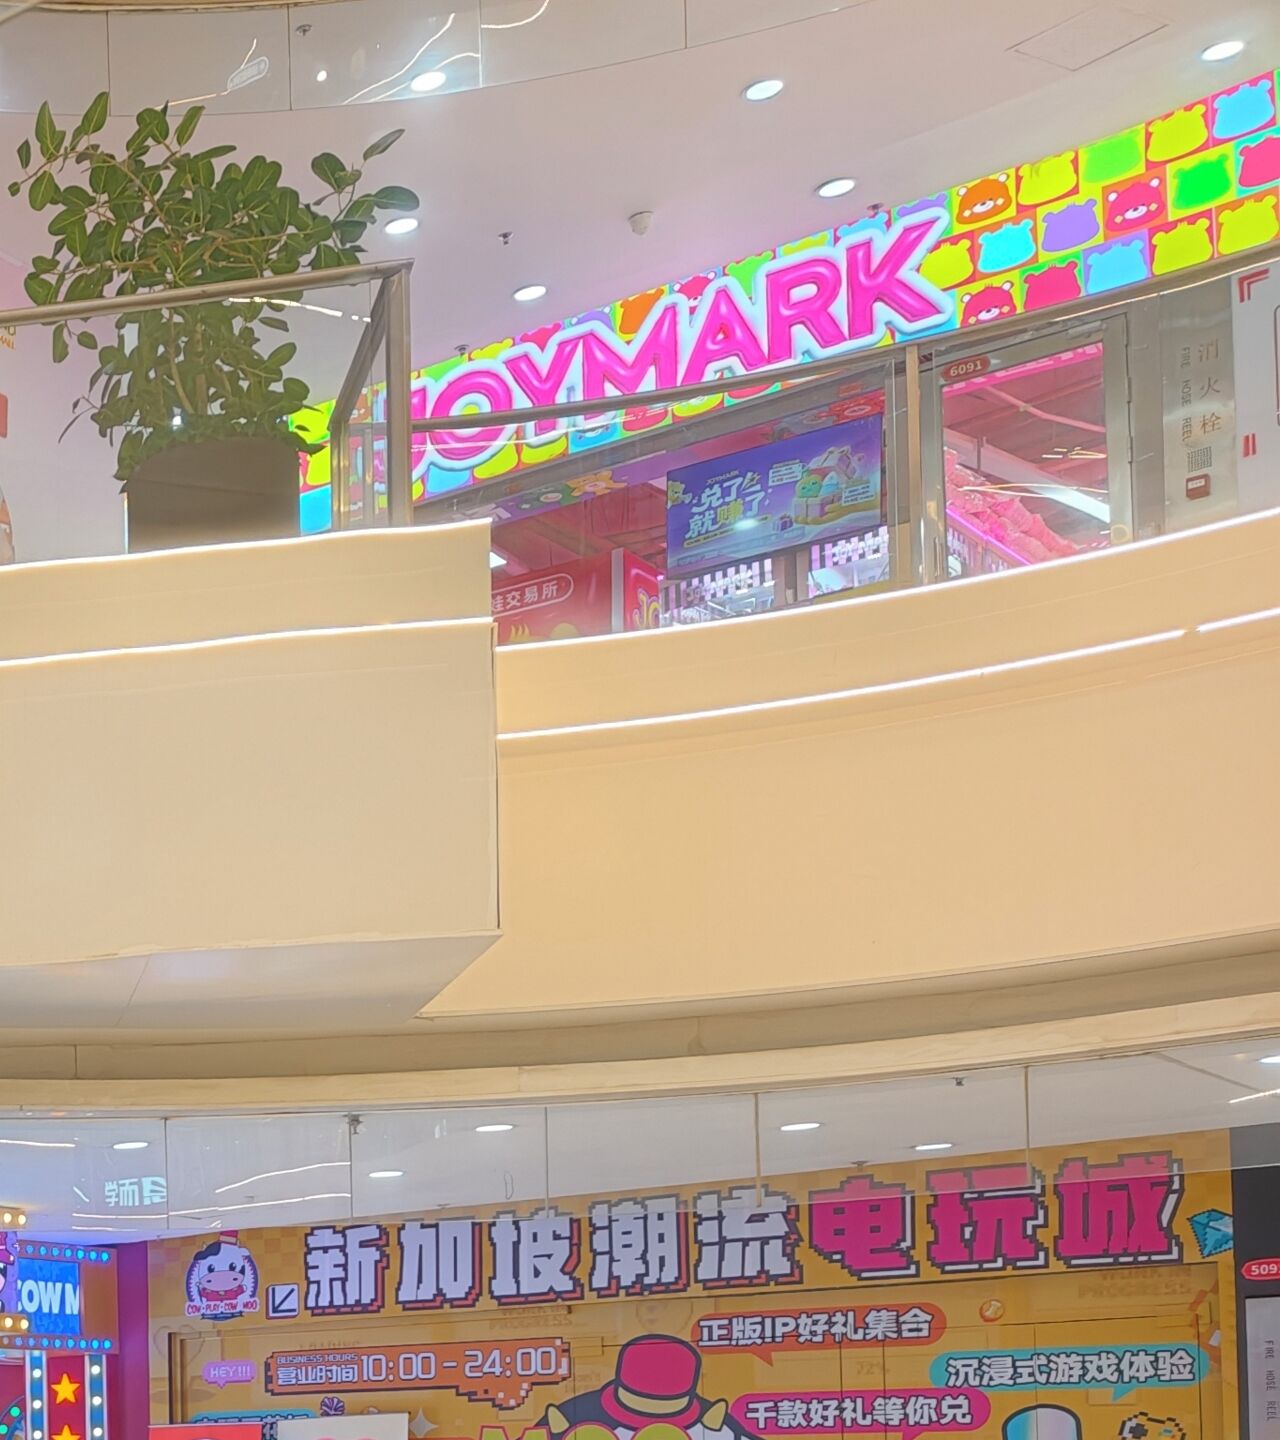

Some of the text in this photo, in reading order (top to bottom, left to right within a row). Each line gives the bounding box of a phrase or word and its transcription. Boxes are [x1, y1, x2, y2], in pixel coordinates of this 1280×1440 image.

[950, 360, 982, 377] 6091
[1197, 340, 1222, 434] 消火栓
[305, 1154, 1186, 1318] 新加坡潮流电玩城
[1251, 1264, 1280, 1276] 509
[18, 1279, 62, 1314] OW
[697, 1308, 934, 1346] 正版IP好礼集合
[209, 1365, 252, 1380] HEY!!!
[276, 1365, 358, 1386] 营业时间
[277, 1353, 358, 1365] BUSINESS HOURS
[361, 1353, 436, 1382] 10:00
[464, 1347, 557, 1378] 24:00
[945, 1349, 1196, 1388] 沉浸式游戏体验
[745, 1394, 973, 1429] 千款好礼等你兑
